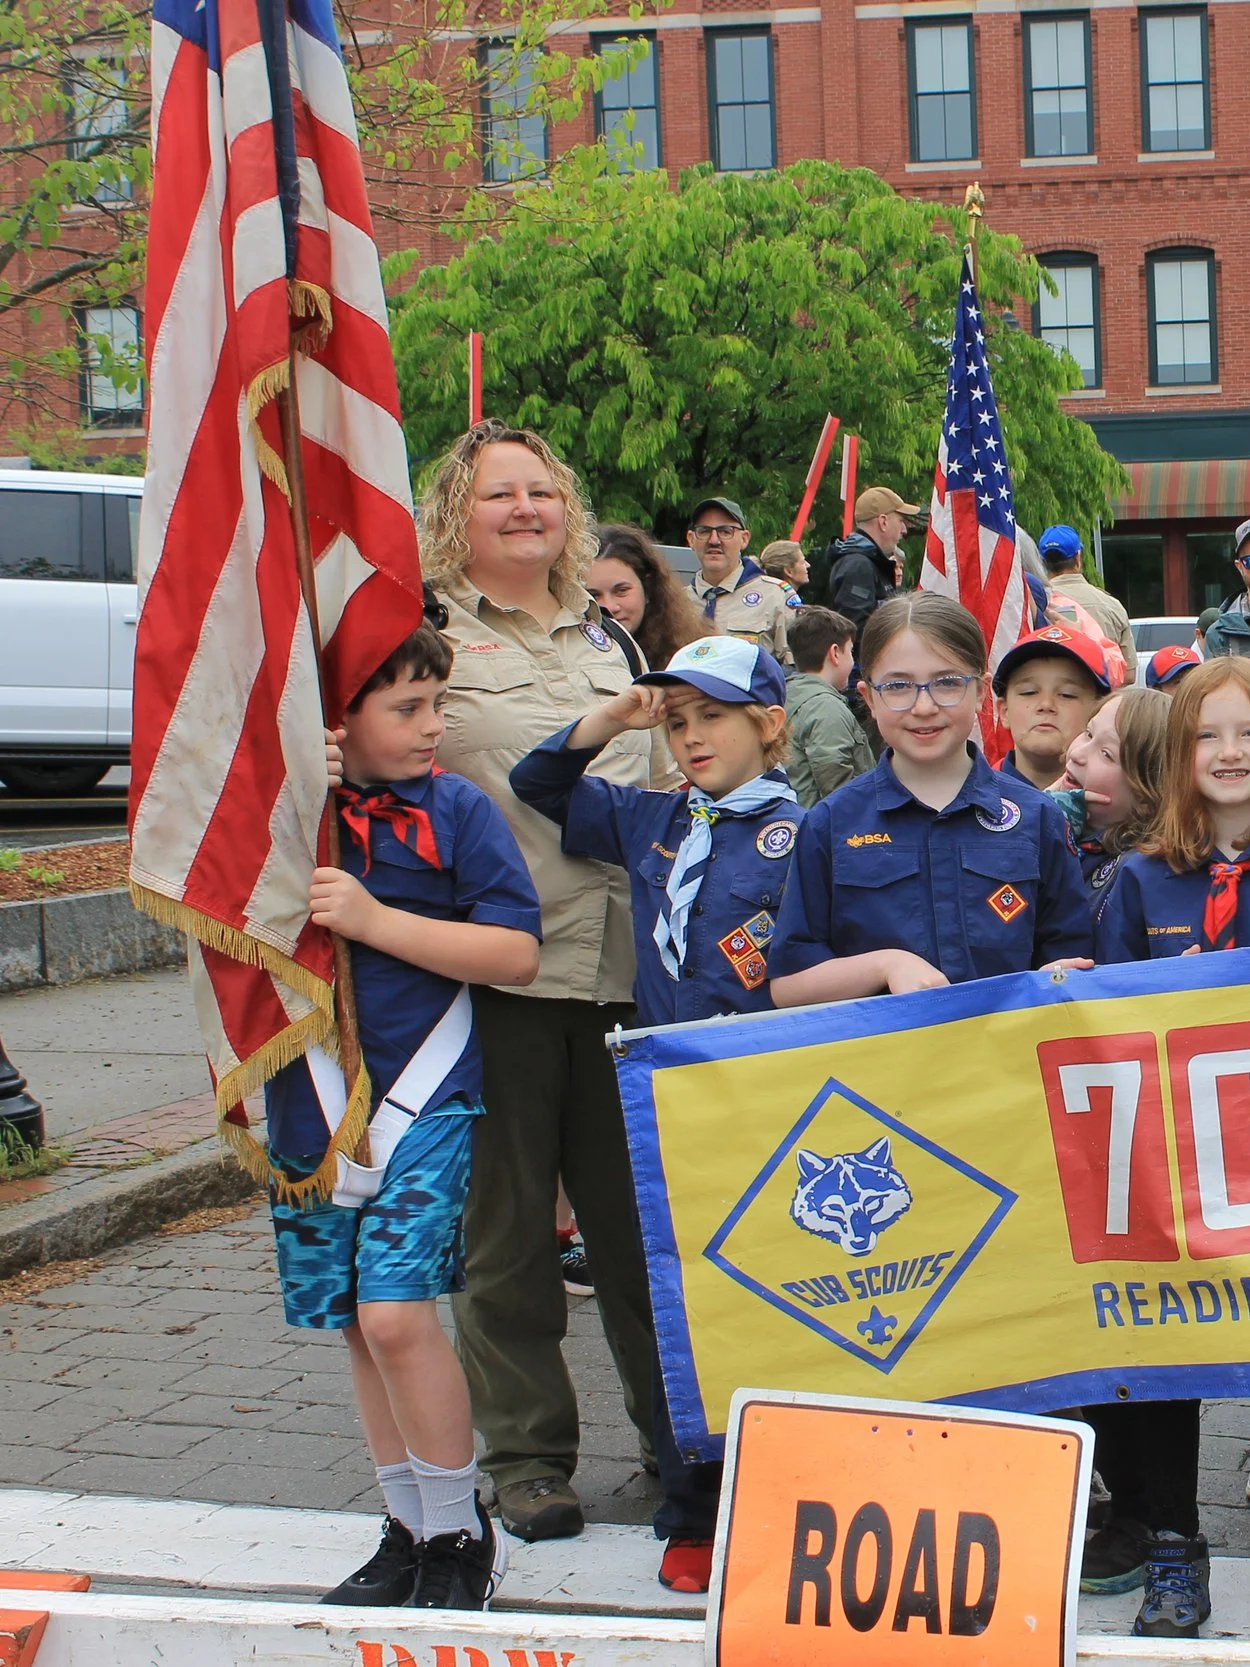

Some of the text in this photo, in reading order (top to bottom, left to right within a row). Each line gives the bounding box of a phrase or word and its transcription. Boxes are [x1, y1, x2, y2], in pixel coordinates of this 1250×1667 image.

[864, 833, 893, 845] BSA
[1166, 926, 1192, 934] AMERICA
[780, 1250, 956, 1308] CUB SCOUTS
[784, 1499, 1001, 1637] ROAD
